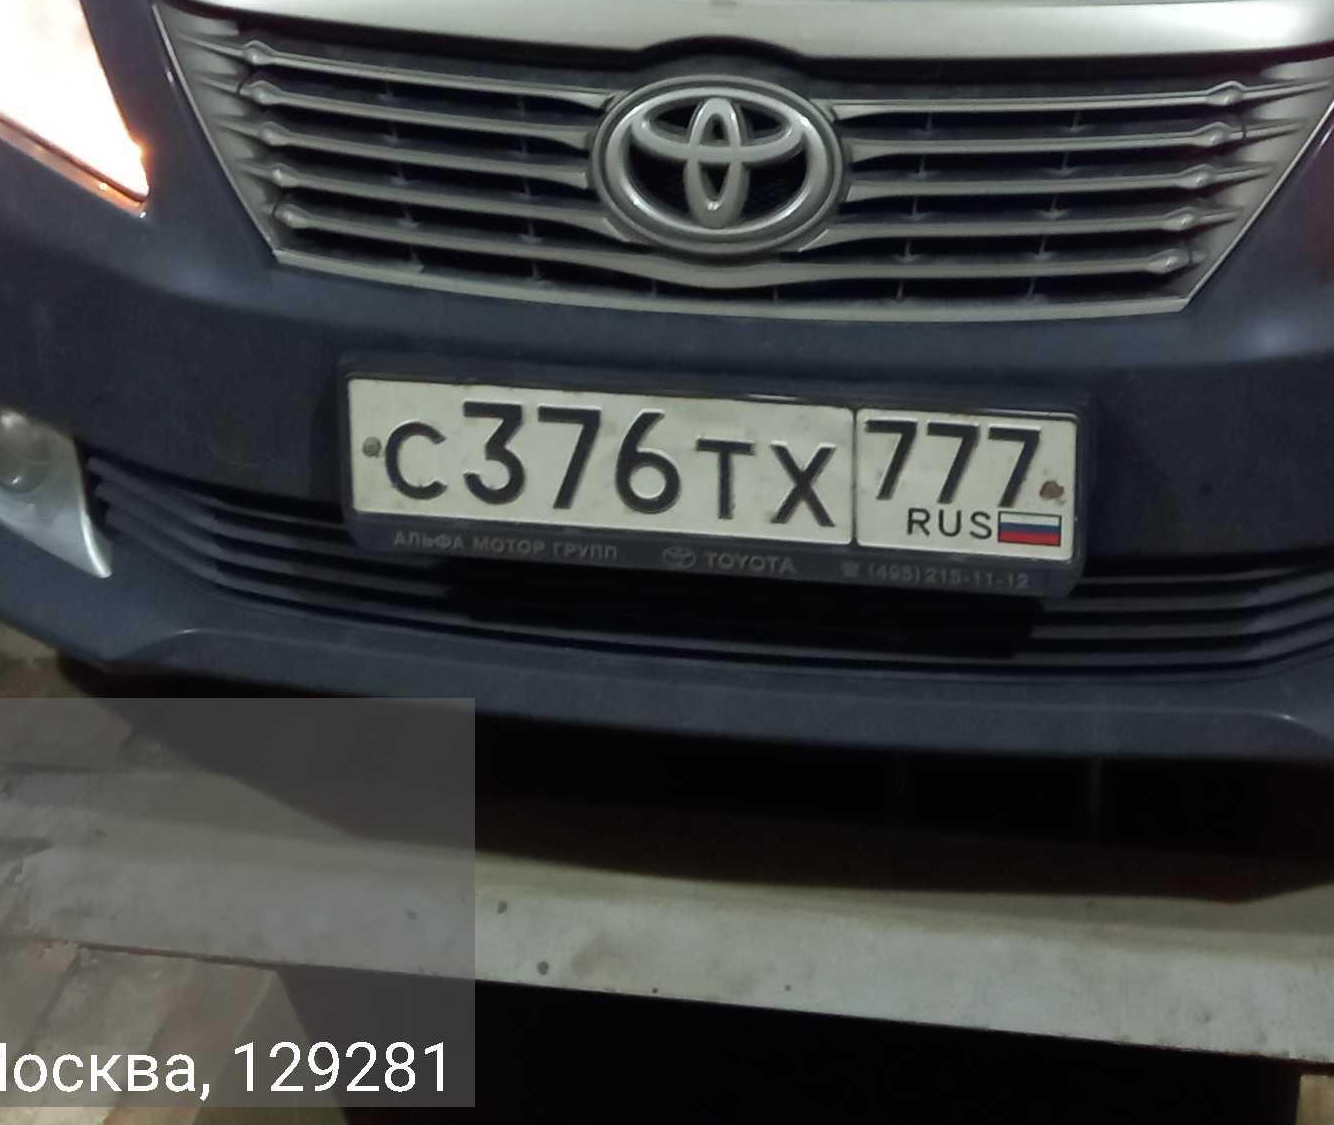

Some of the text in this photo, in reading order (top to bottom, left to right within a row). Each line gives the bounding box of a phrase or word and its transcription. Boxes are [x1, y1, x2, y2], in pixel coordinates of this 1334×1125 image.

[384, 400, 835, 527] С376ТХ
[864, 418, 1040, 508] 777
[907, 508, 992, 540] RUS
[394, 530, 618, 561] АЛЬФА МОТОР ГРУПП
[705, 552, 797, 574] TOYOTA
